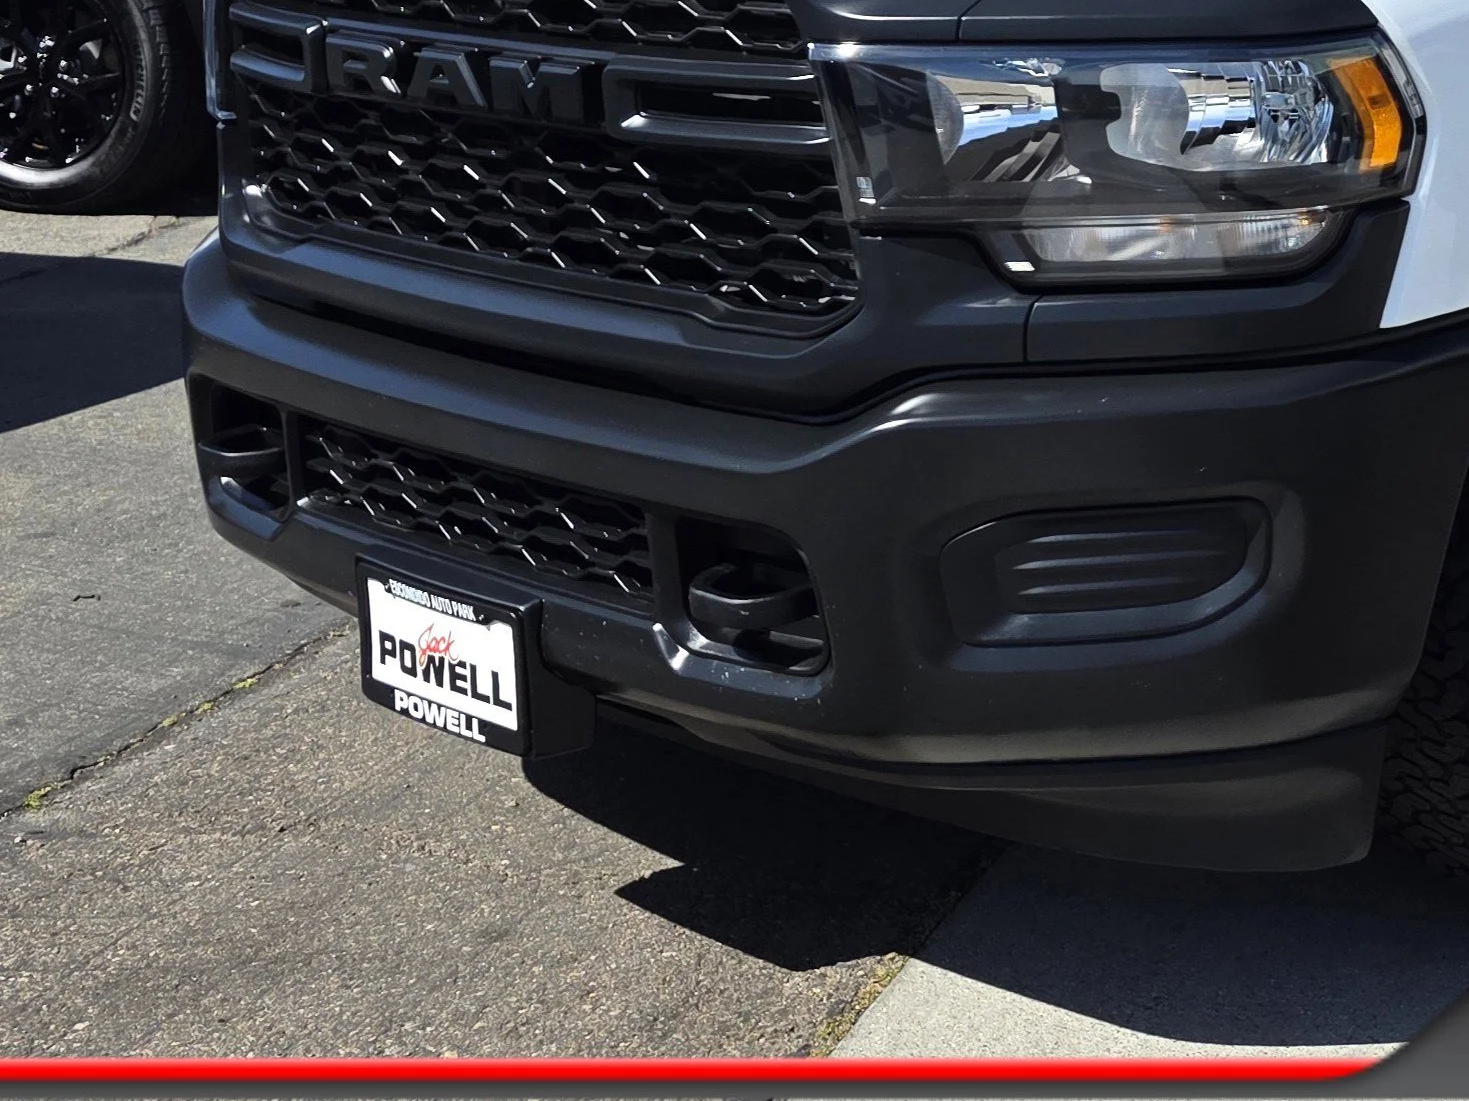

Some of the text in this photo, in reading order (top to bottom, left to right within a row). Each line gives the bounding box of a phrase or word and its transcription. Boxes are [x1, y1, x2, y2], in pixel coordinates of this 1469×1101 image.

[325, 35, 590, 124] RAM
[379, 630, 513, 711] POWELL
[418, 623, 459, 668] Jack
[394, 689, 486, 743] POWELL
